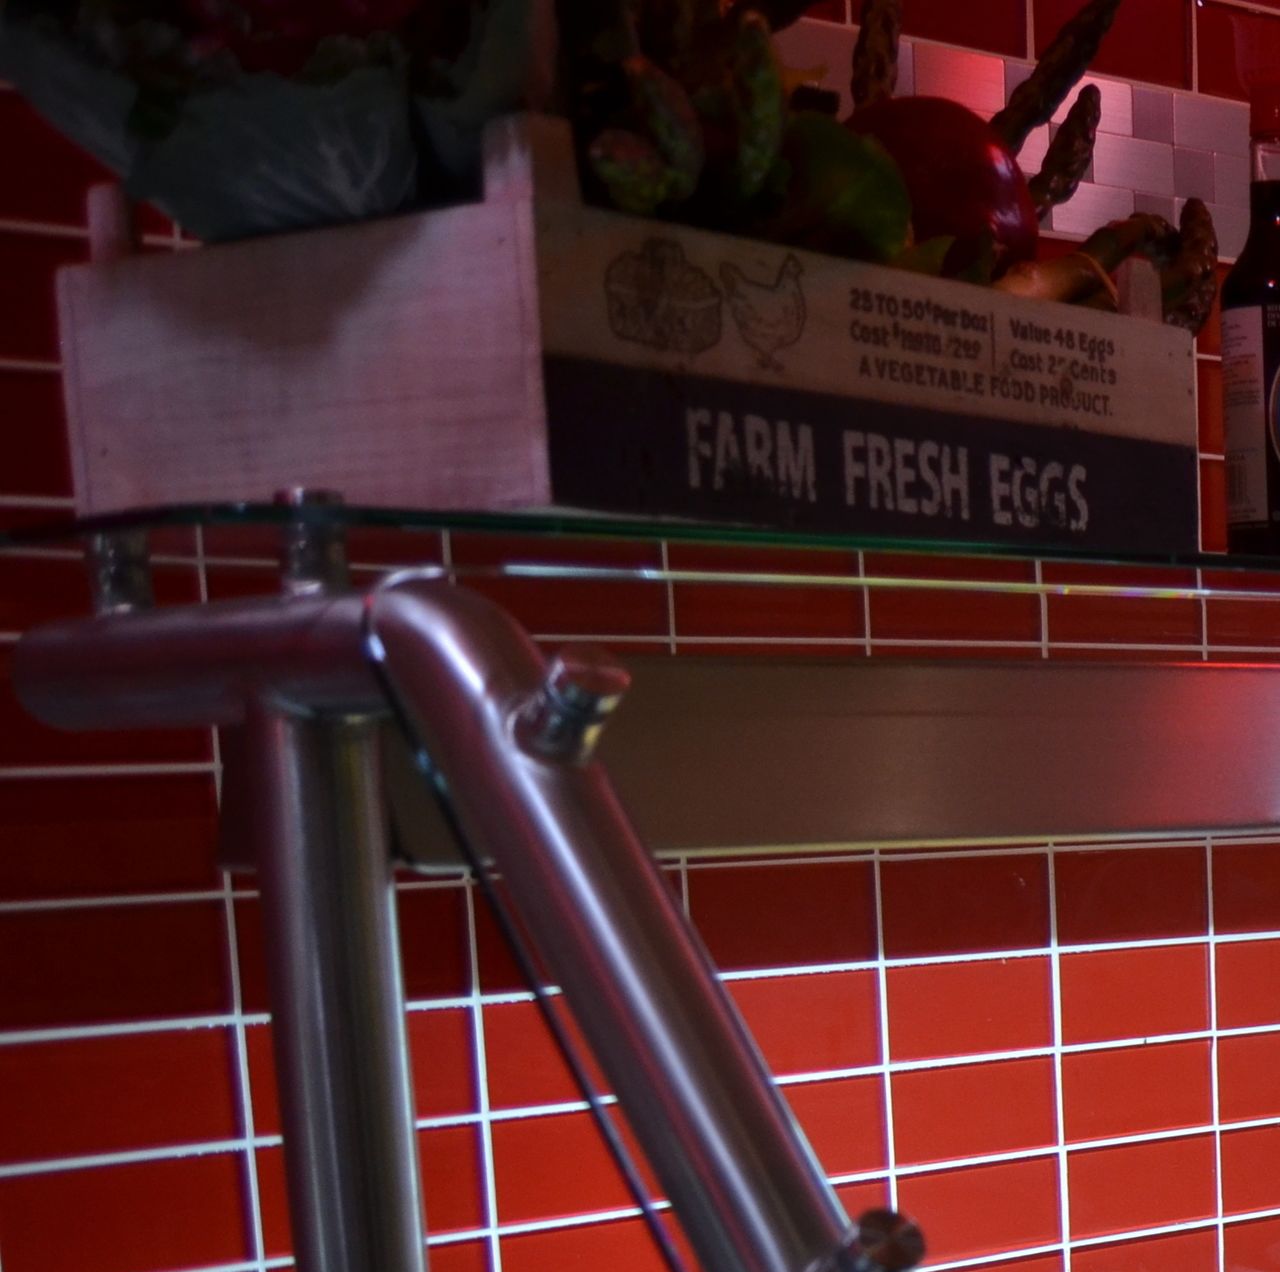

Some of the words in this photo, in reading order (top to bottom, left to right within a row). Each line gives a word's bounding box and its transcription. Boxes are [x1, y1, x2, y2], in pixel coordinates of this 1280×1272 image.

[875, 292, 899, 317] TO
[850, 319, 889, 347] Cost
[1009, 317, 1051, 345] Value
[1054, 328, 1075, 350] 48
[1078, 332, 1115, 362] Eggs
[859, 354, 871, 377] A
[874, 357, 985, 396] VEGETABLE
[990, 374, 1035, 403] FOOD
[1070, 359, 1117, 385] Cents
[685, 407, 818, 503] FARM
[842, 429, 972, 522] FRESH
[989, 452, 1090, 533] EGGS
